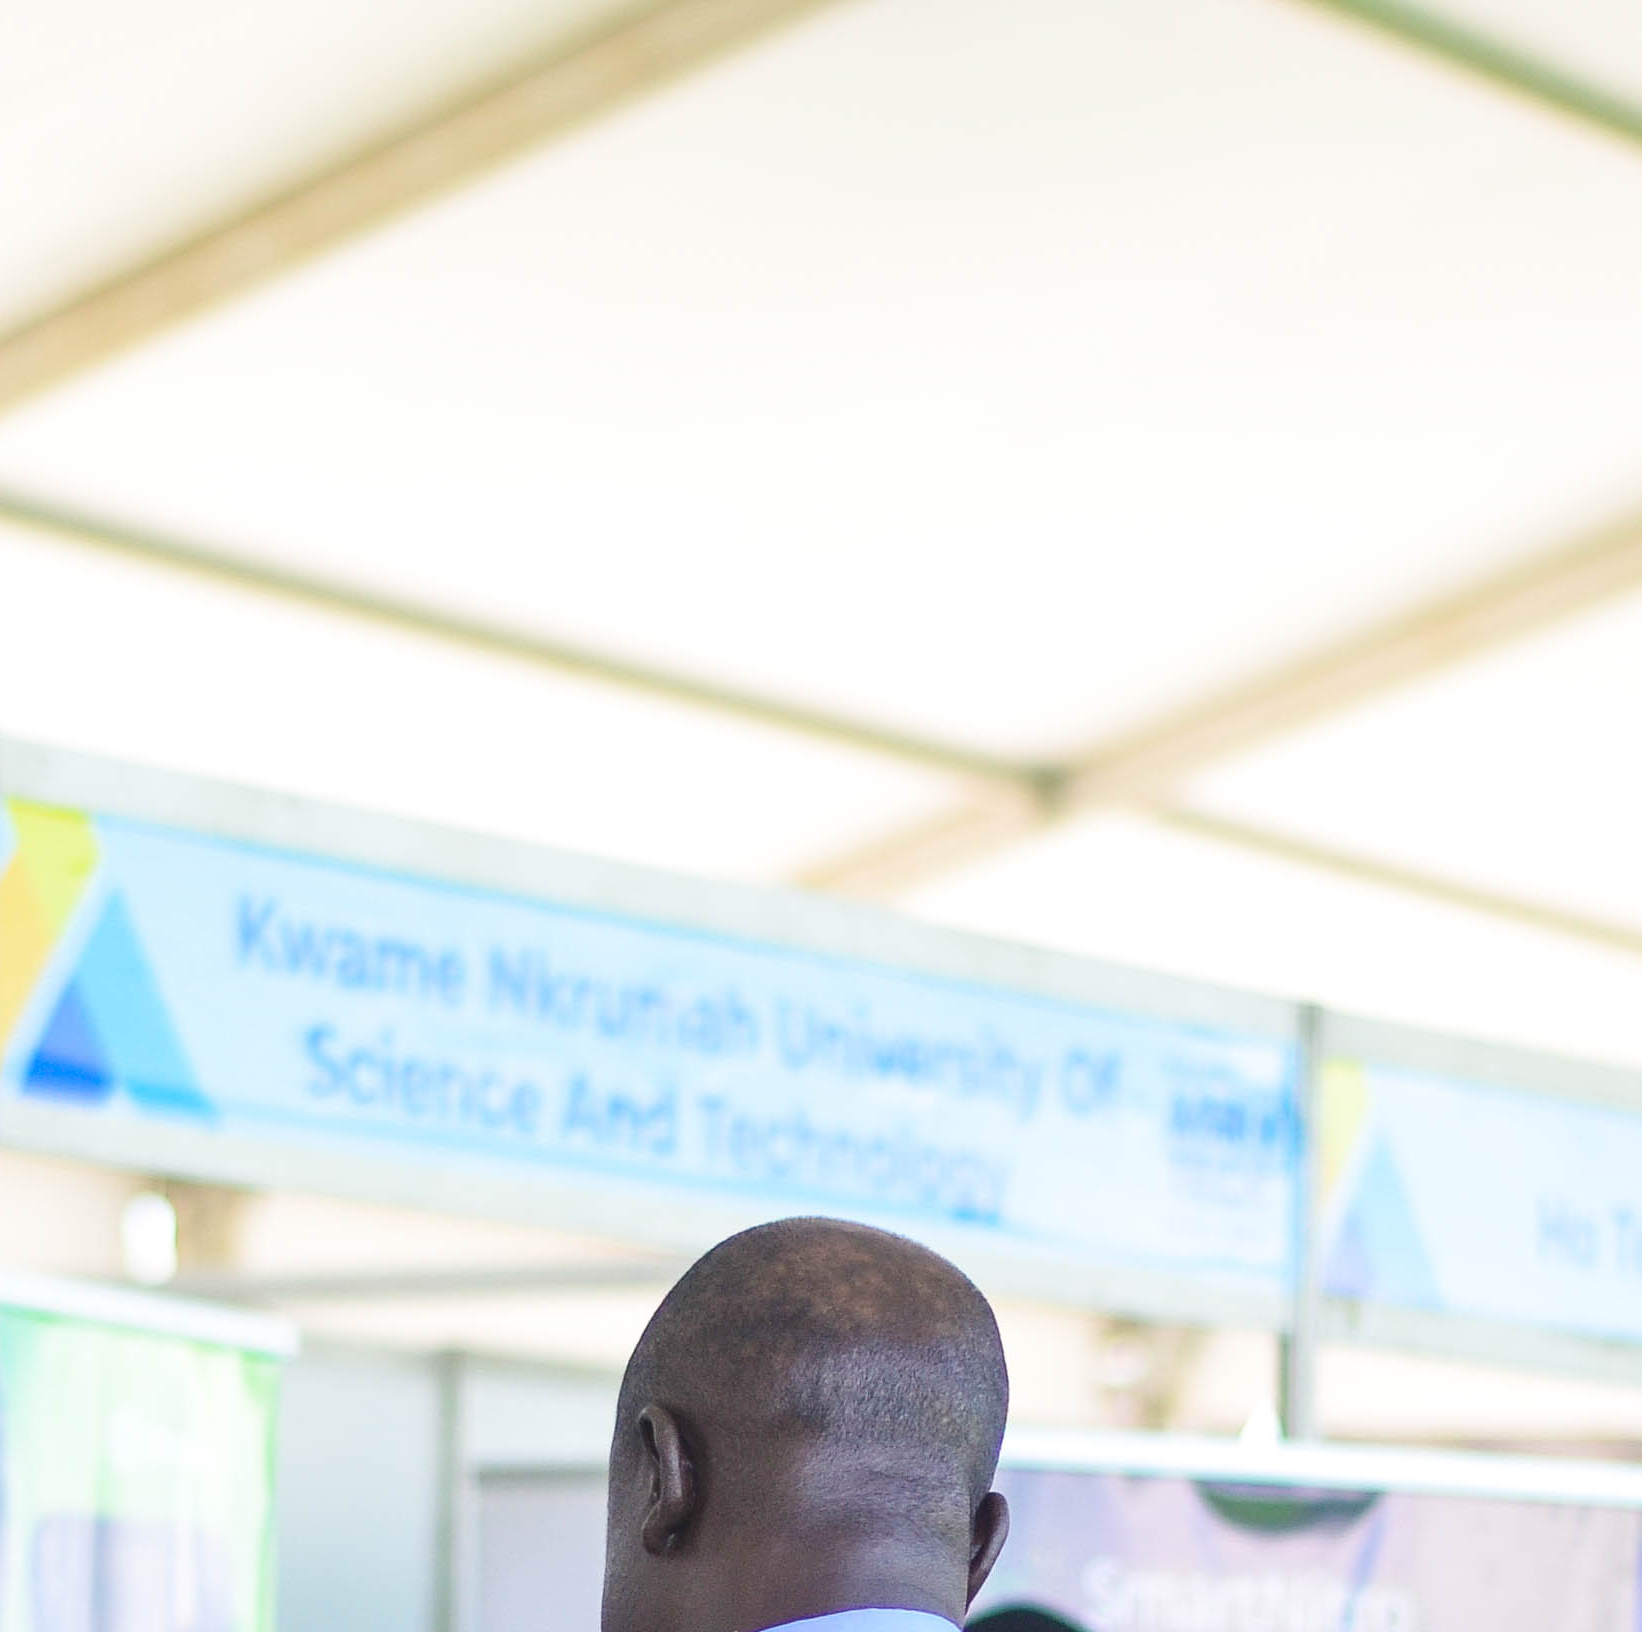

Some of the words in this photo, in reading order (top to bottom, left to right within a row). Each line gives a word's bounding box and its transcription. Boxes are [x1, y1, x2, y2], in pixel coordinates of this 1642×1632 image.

[234, 893, 464, 1004] Kwame
[774, 998, 1041, 1122] University
[300, 1020, 543, 1136] Science
[561, 1072, 677, 1158] And
